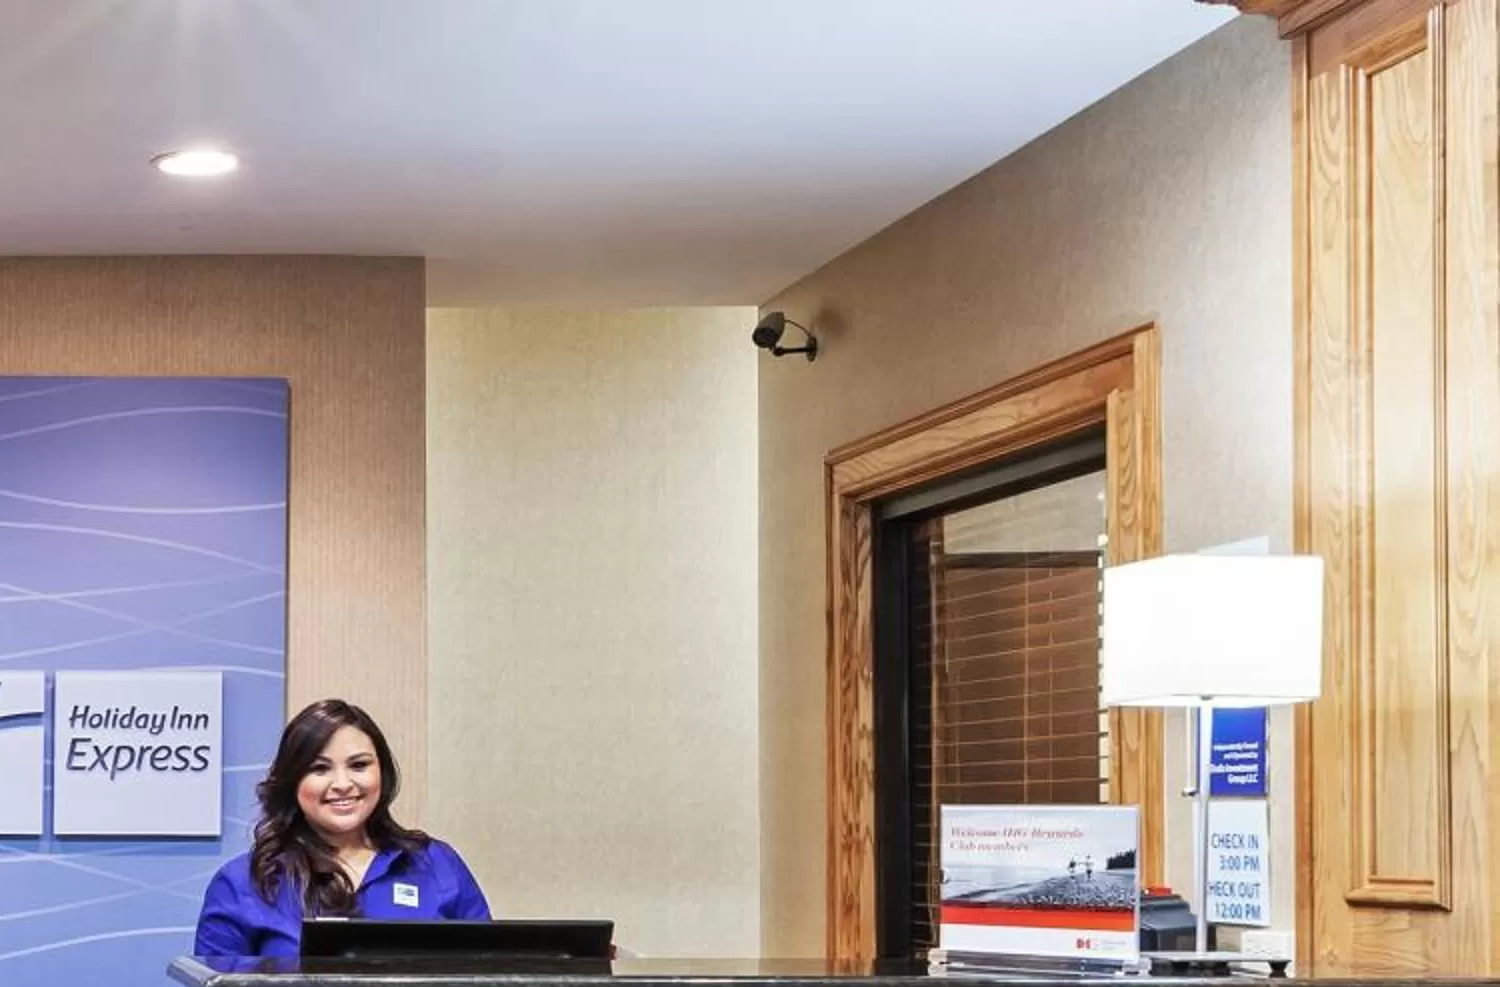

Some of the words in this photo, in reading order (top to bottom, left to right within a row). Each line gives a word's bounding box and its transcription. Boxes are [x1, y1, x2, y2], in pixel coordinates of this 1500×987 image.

[68, 704, 167, 735] Holiday
[170, 705, 210, 731] Inn
[65, 737, 212, 781] Express
[1211, 832, 1245, 849] CHECK
[1247, 833, 1259, 849] IN
[1220, 855, 1242, 871] 3:00
[1243, 855, 1260, 872] PM
[1208, 881, 1237, 898] HECK
[1238, 881, 1261, 898] OUT
[1214, 902, 1243, 919] 12:00
[1245, 903, 1262, 920] PM
